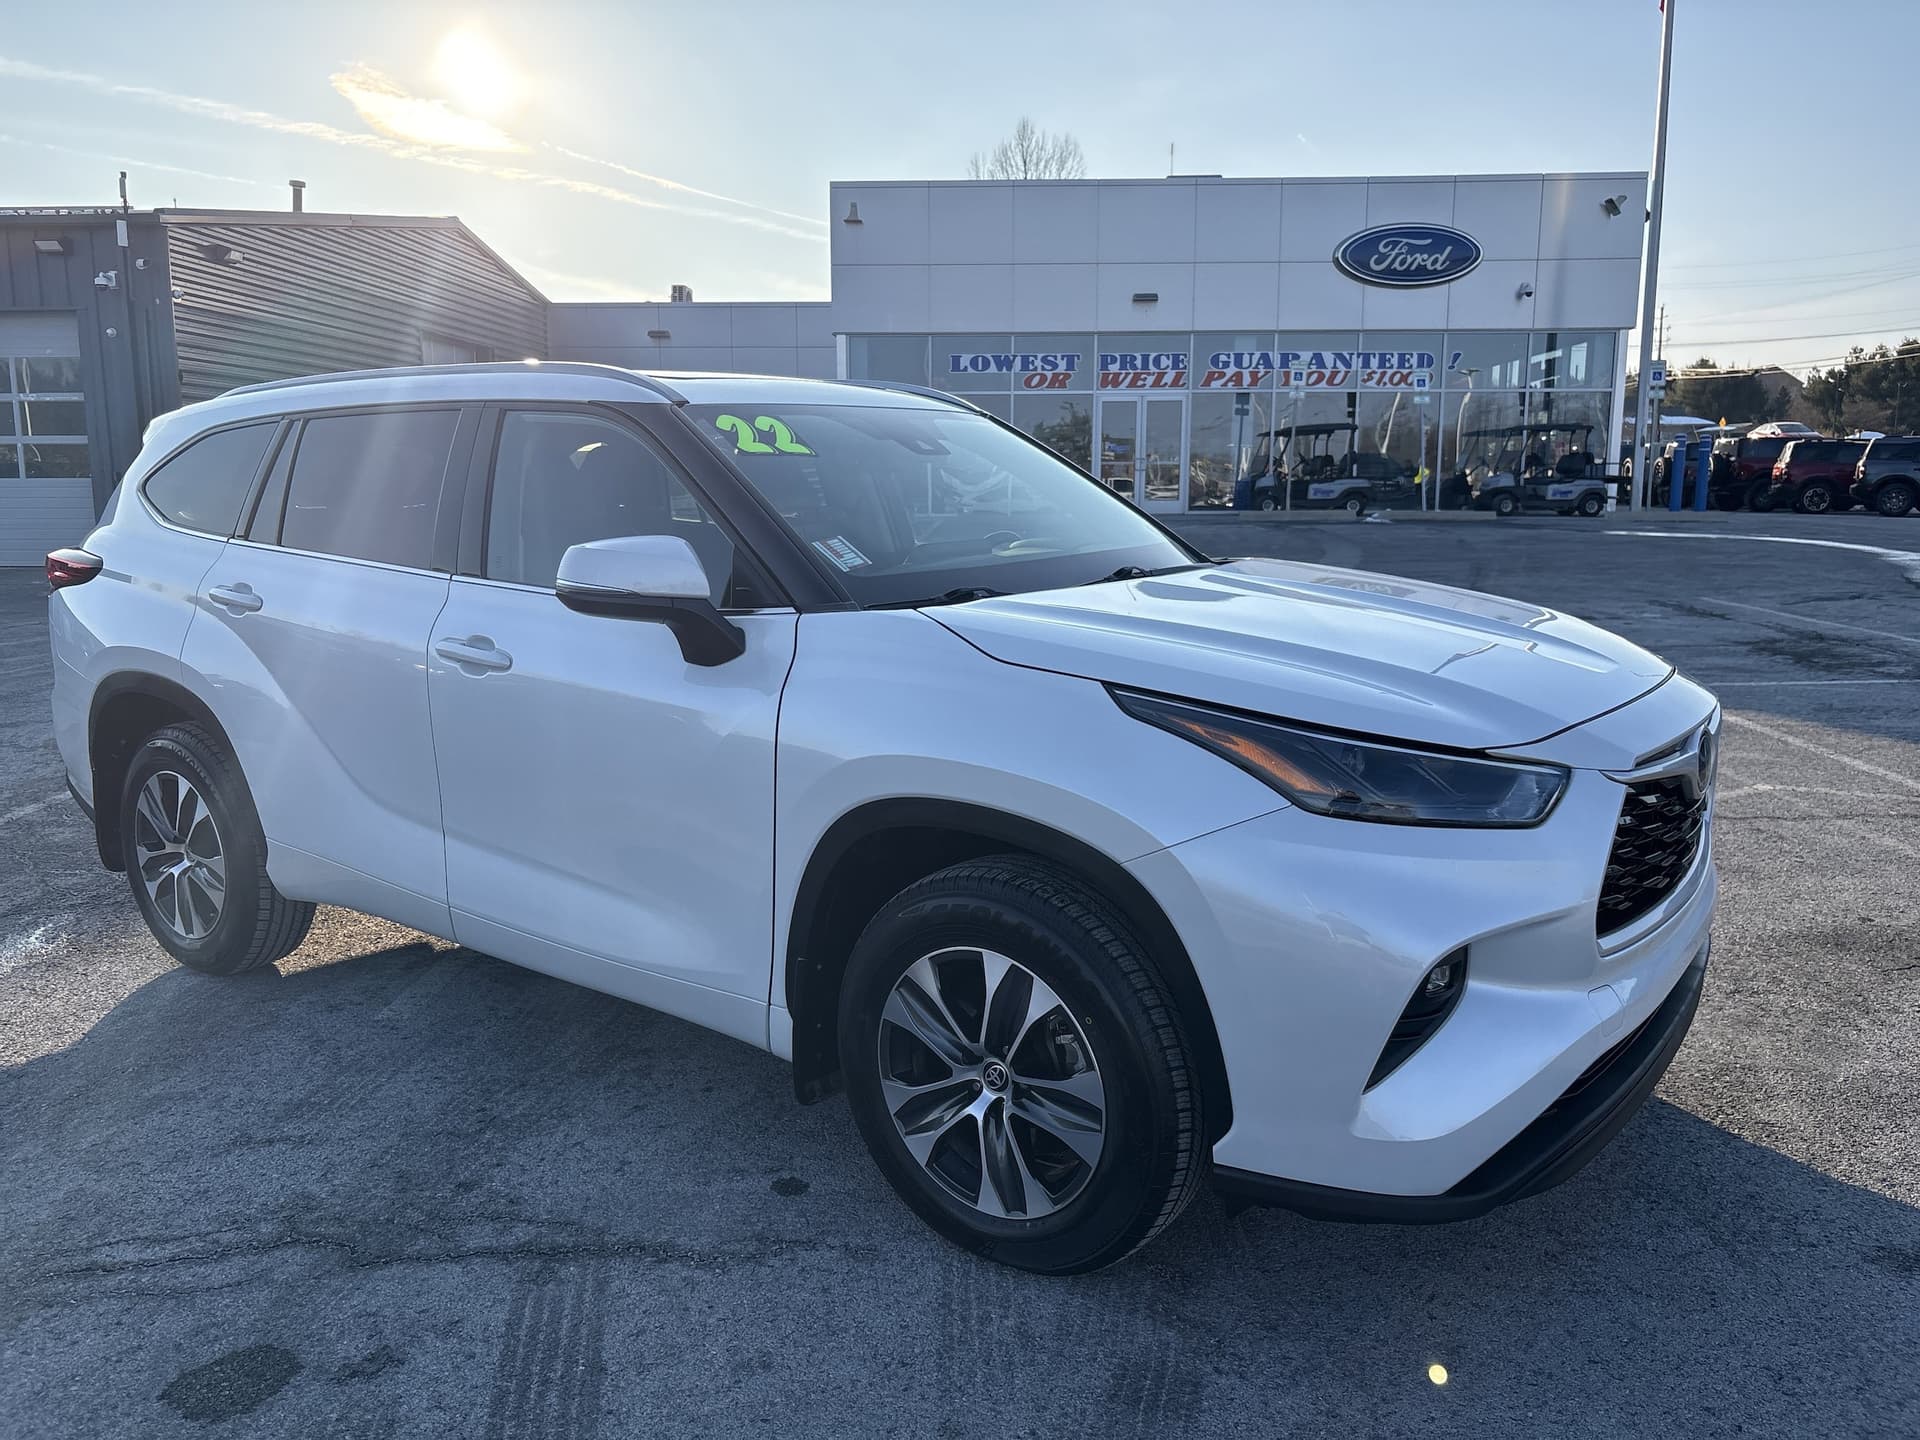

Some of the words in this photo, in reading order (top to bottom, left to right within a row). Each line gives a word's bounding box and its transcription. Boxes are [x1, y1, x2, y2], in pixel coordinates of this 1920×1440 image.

[1370, 237, 1453, 271] Ford
[950, 354, 1081, 372] LOWEST
[1099, 353, 1188, 371] PRICE
[1209, 352, 1435, 370] GUARANTEED
[1023, 372, 1073, 389] OR
[1098, 371, 1187, 389] WE'LL
[1200, 370, 1271, 388] PAY
[1360, 370, 1434, 387] $1,00
[715, 414, 816, 455] 22
